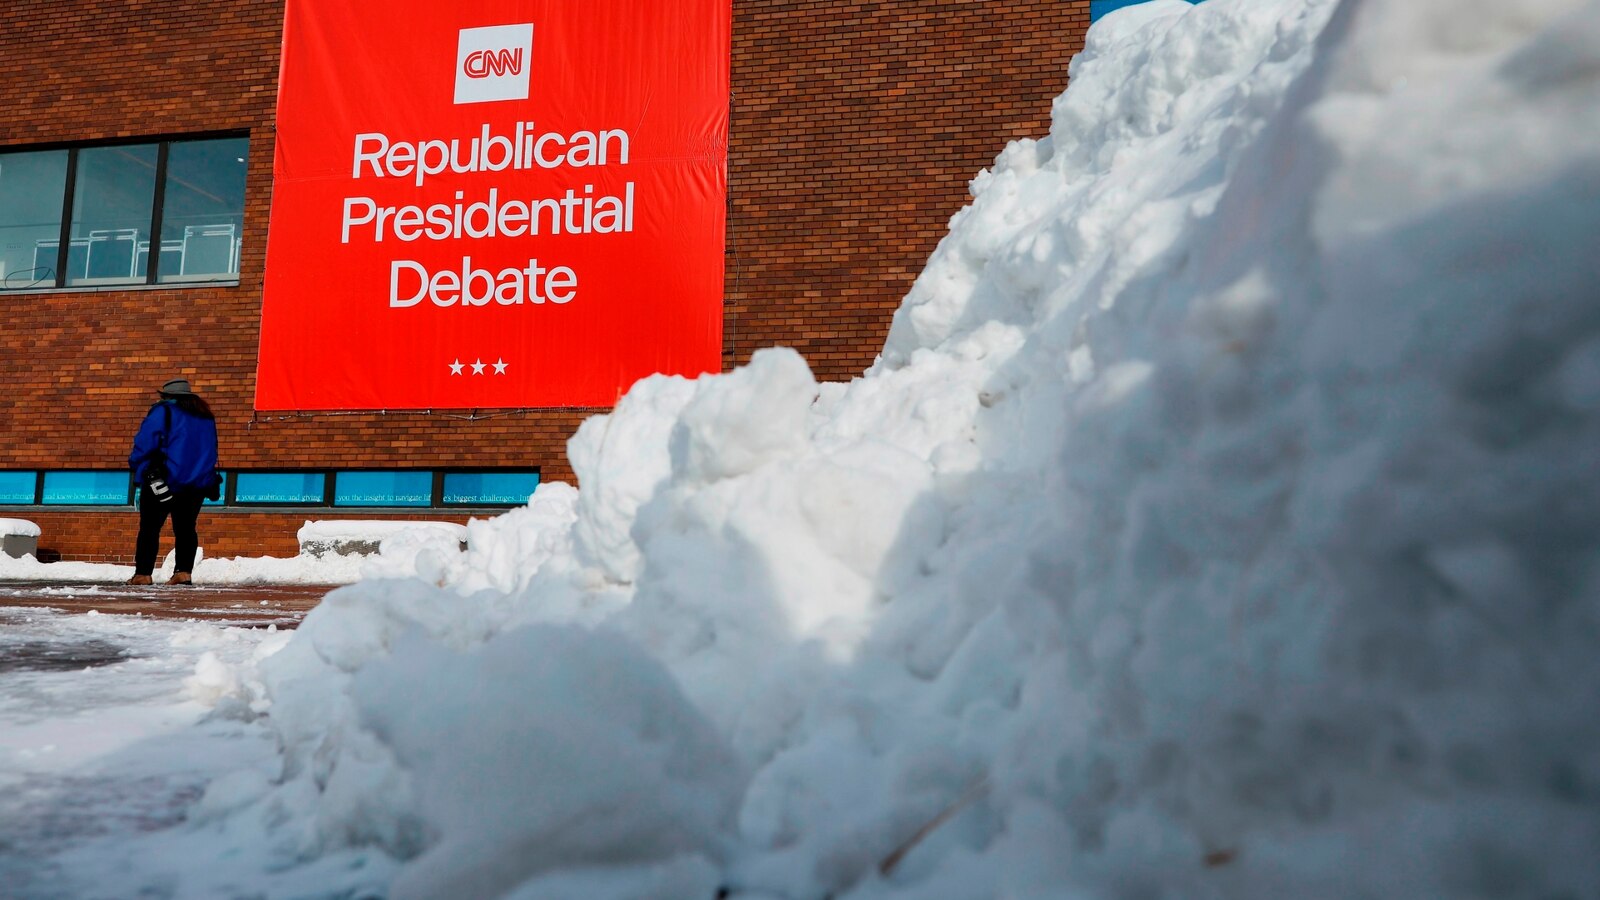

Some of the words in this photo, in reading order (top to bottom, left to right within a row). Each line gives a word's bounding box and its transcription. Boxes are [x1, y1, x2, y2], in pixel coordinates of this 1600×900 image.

[463, 47, 523, 79] CNN
[352, 121, 630, 187] Republican
[341, 181, 635, 244] Presidential
[389, 256, 578, 308] Debate
[241, 494, 257, 502] your
[288, 493, 300, 501] and
[301, 493, 321, 502] giving
[338, 494, 350, 502] you
[351, 493, 363, 501] the
[363, 493, 385, 502] insight
[387, 493, 394, 501] to
[395, 493, 423, 502] navigate
[453, 493, 477, 503] biggest
